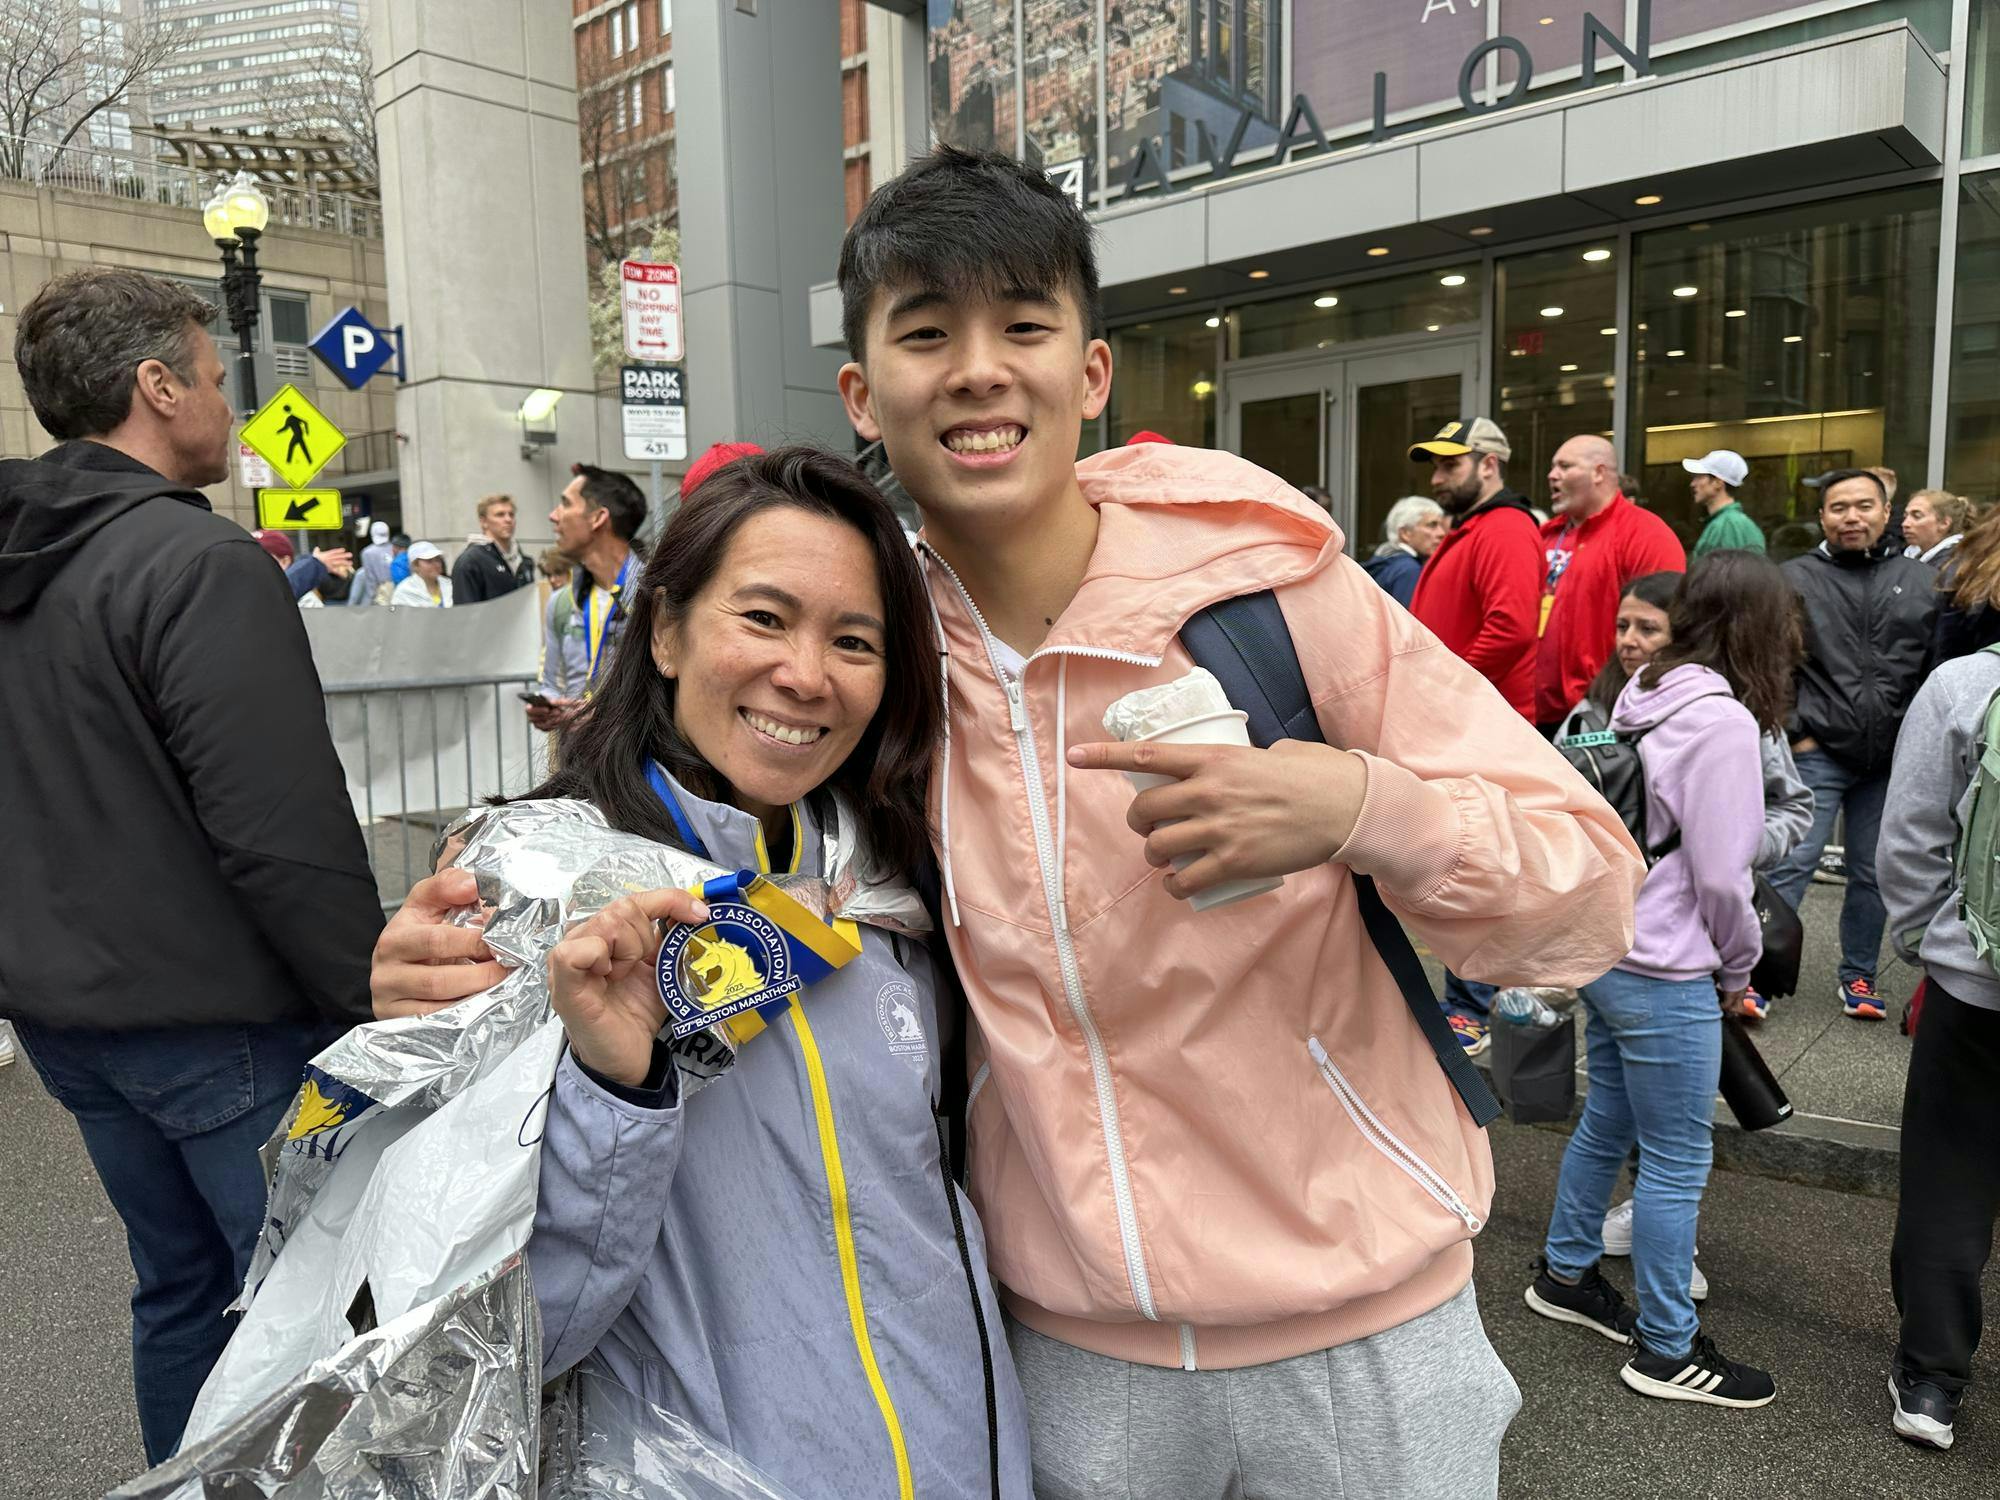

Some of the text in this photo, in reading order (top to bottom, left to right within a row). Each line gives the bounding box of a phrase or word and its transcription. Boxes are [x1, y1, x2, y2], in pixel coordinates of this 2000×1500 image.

[1123, 0, 1651, 197] AVALON
[646, 268, 674, 282] ZONE
[638, 288, 660, 301] NO
[626, 301, 677, 313] STOPPING
[640, 315, 661, 325] ANY
[640, 327, 664, 337] TIME
[342, 325, 374, 368] P
[624, 371, 679, 388] PARK
[624, 387, 681, 400] BOSTON
[645, 442, 669, 455] 431
[662, 908, 785, 1017] BOSTON ATHLIC ASSOCIATION
[725, 983, 744, 995] 2023
[880, 984, 902, 1004] ATHLETIC
[695, 1004, 738, 1027] BOSTON
[738, 980, 797, 1010] MARATHON
[879, 1004, 895, 1038] BOSTON
[888, 1044, 911, 1053] BOSTON
